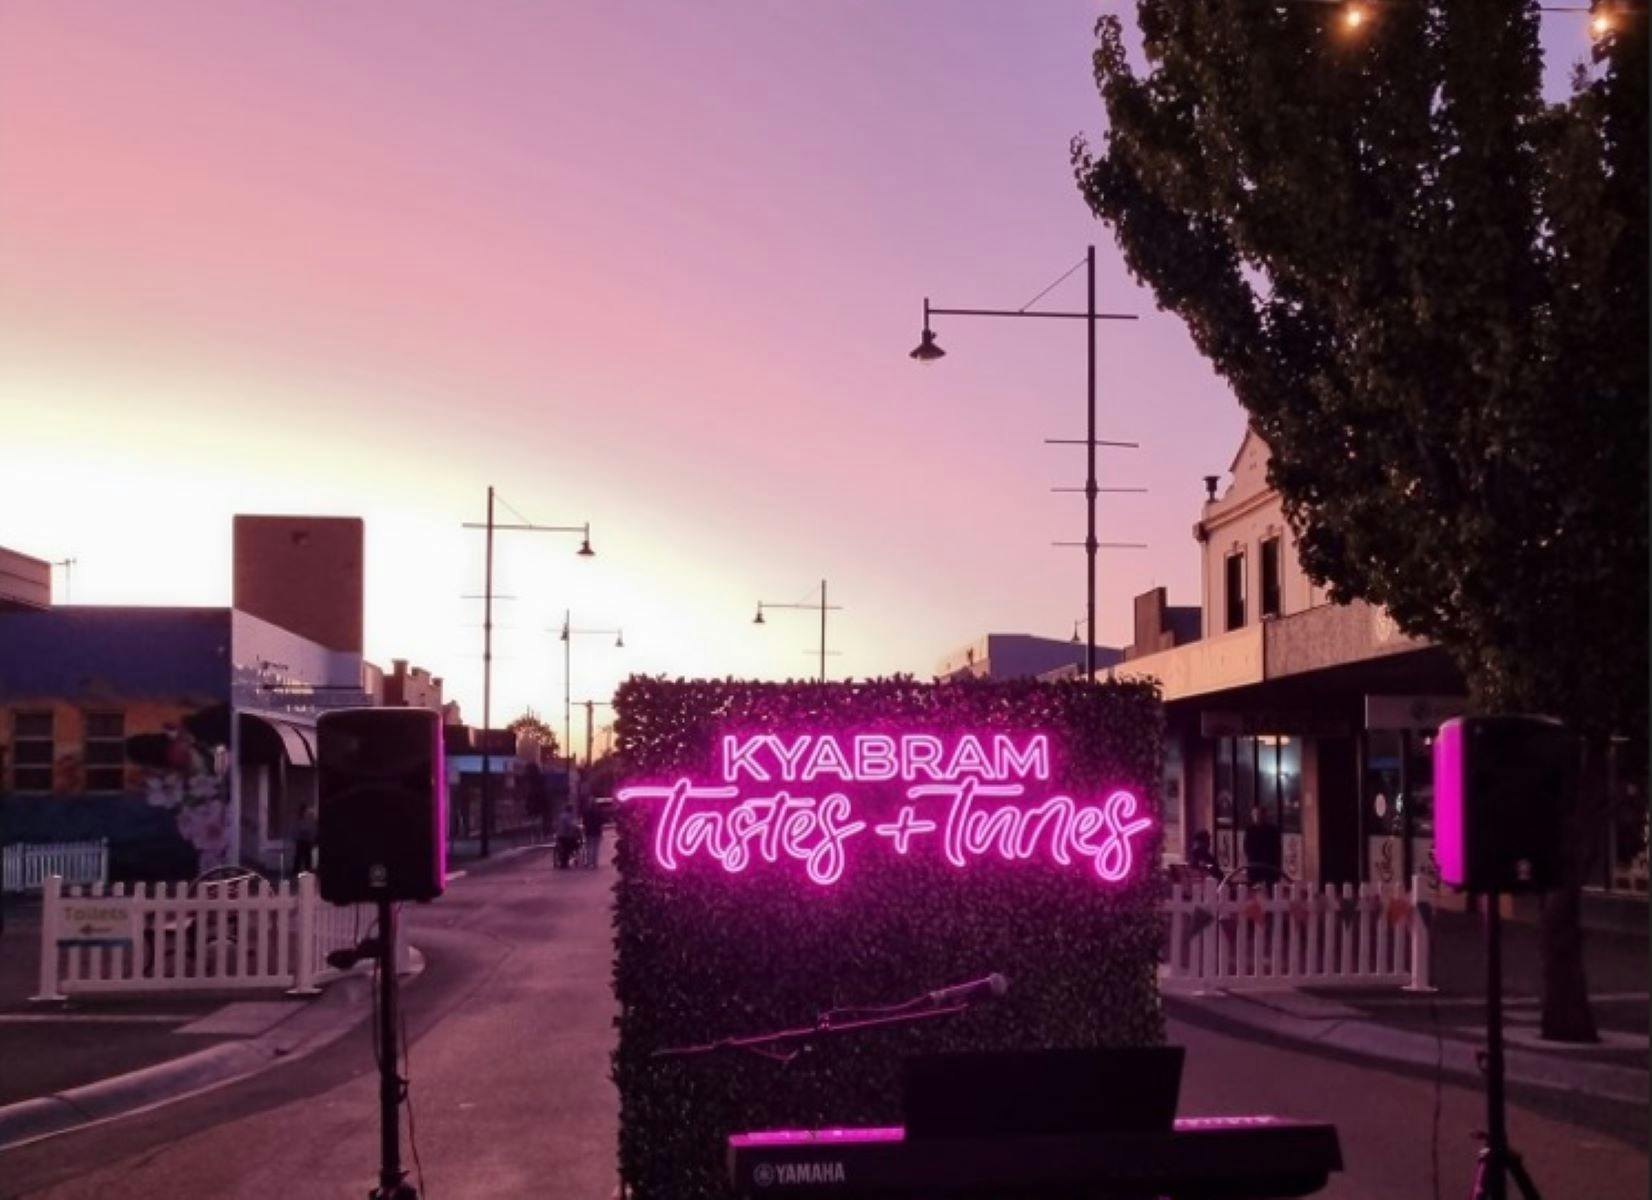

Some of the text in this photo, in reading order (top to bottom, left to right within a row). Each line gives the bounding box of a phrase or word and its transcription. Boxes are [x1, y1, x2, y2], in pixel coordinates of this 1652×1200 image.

[722, 734, 1050, 782] KYABRAM
[616, 777, 866, 885] Tastes
[906, 775, 1153, 882] Tunes
[776, 1162, 846, 1184] YAMAHA
